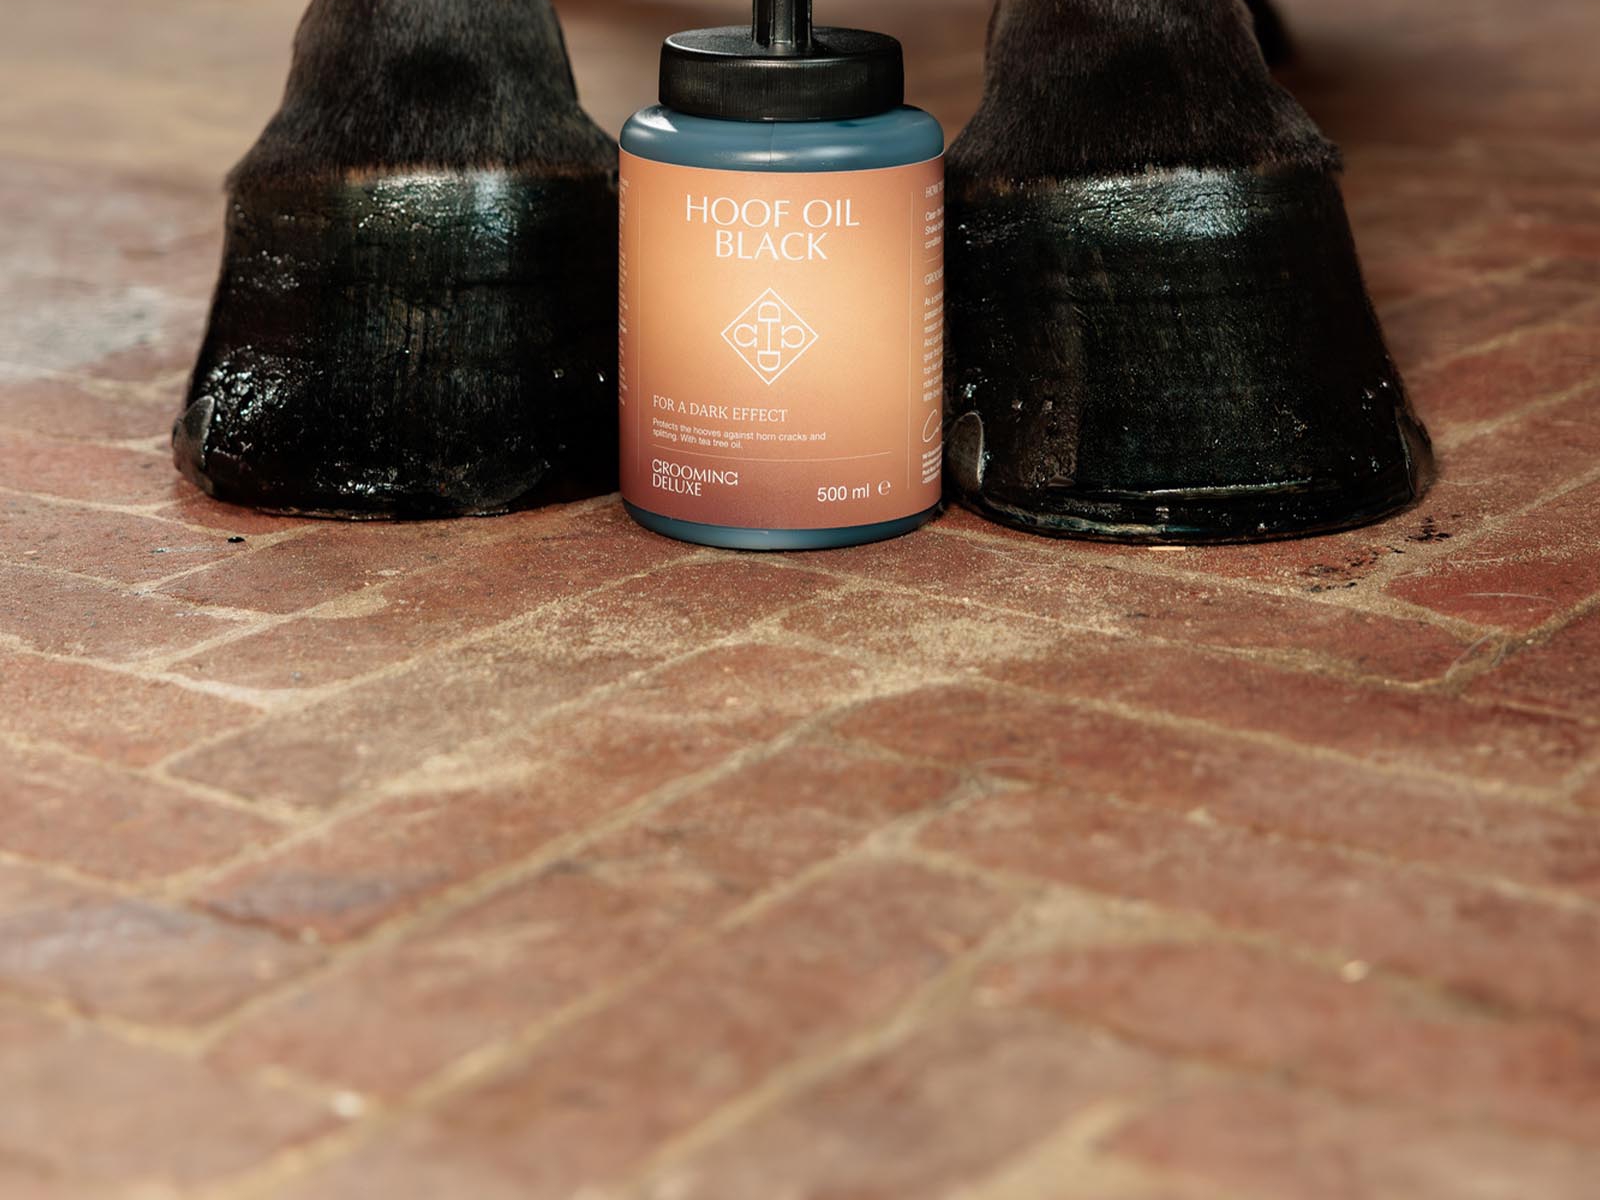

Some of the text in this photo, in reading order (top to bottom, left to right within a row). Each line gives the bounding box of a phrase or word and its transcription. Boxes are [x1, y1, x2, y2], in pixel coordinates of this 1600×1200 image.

[686, 194, 860, 228] HOOF OIL
[715, 230, 828, 261] BLACK
[653, 394, 788, 423] FOR A DARK EFFECT
[652, 417, 827, 441] Protects the hooves against horn cracks and
[680, 433, 697, 443] With
[699, 437, 711, 446] tea
[713, 439, 729, 448] tree
[652, 458, 738, 486] GROOMING
[652, 473, 702, 496] DELUXE
[816, 486, 847, 503] 500
[851, 483, 870, 499] ml
